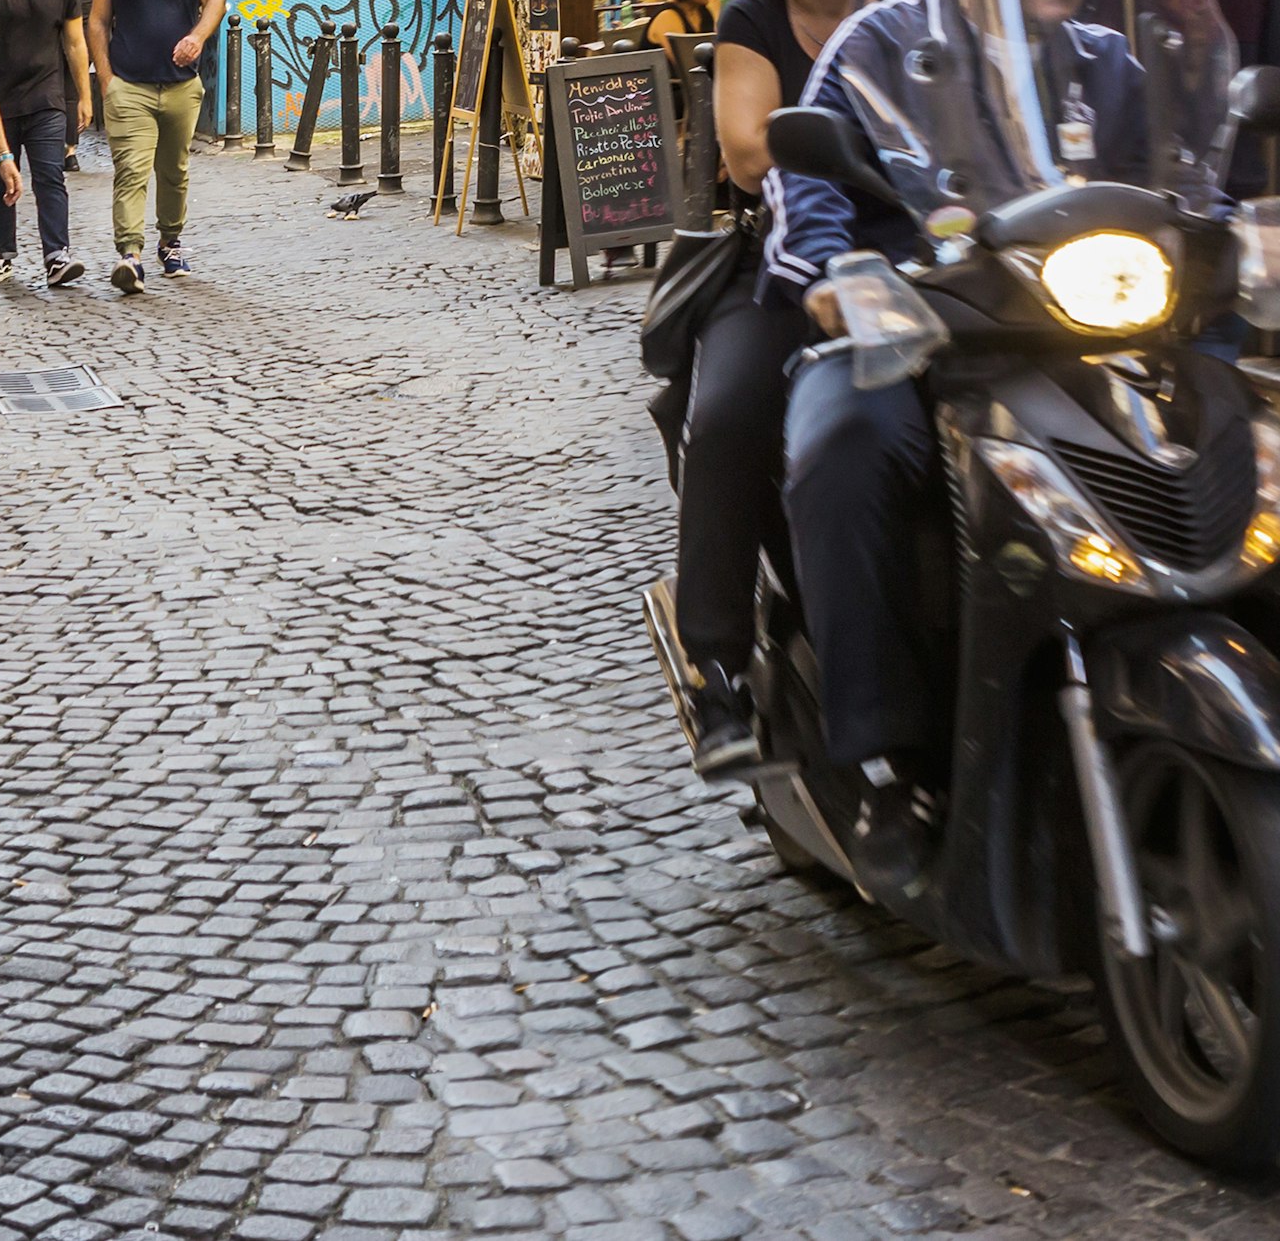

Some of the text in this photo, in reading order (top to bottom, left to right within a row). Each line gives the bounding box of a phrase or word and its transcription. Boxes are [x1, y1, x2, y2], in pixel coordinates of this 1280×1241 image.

[577, 141, 619, 157] Risotto
[577, 151, 635, 172] Carbonara
[578, 164, 638, 186] Sorrentina
[582, 180, 646, 201] Bolognese
